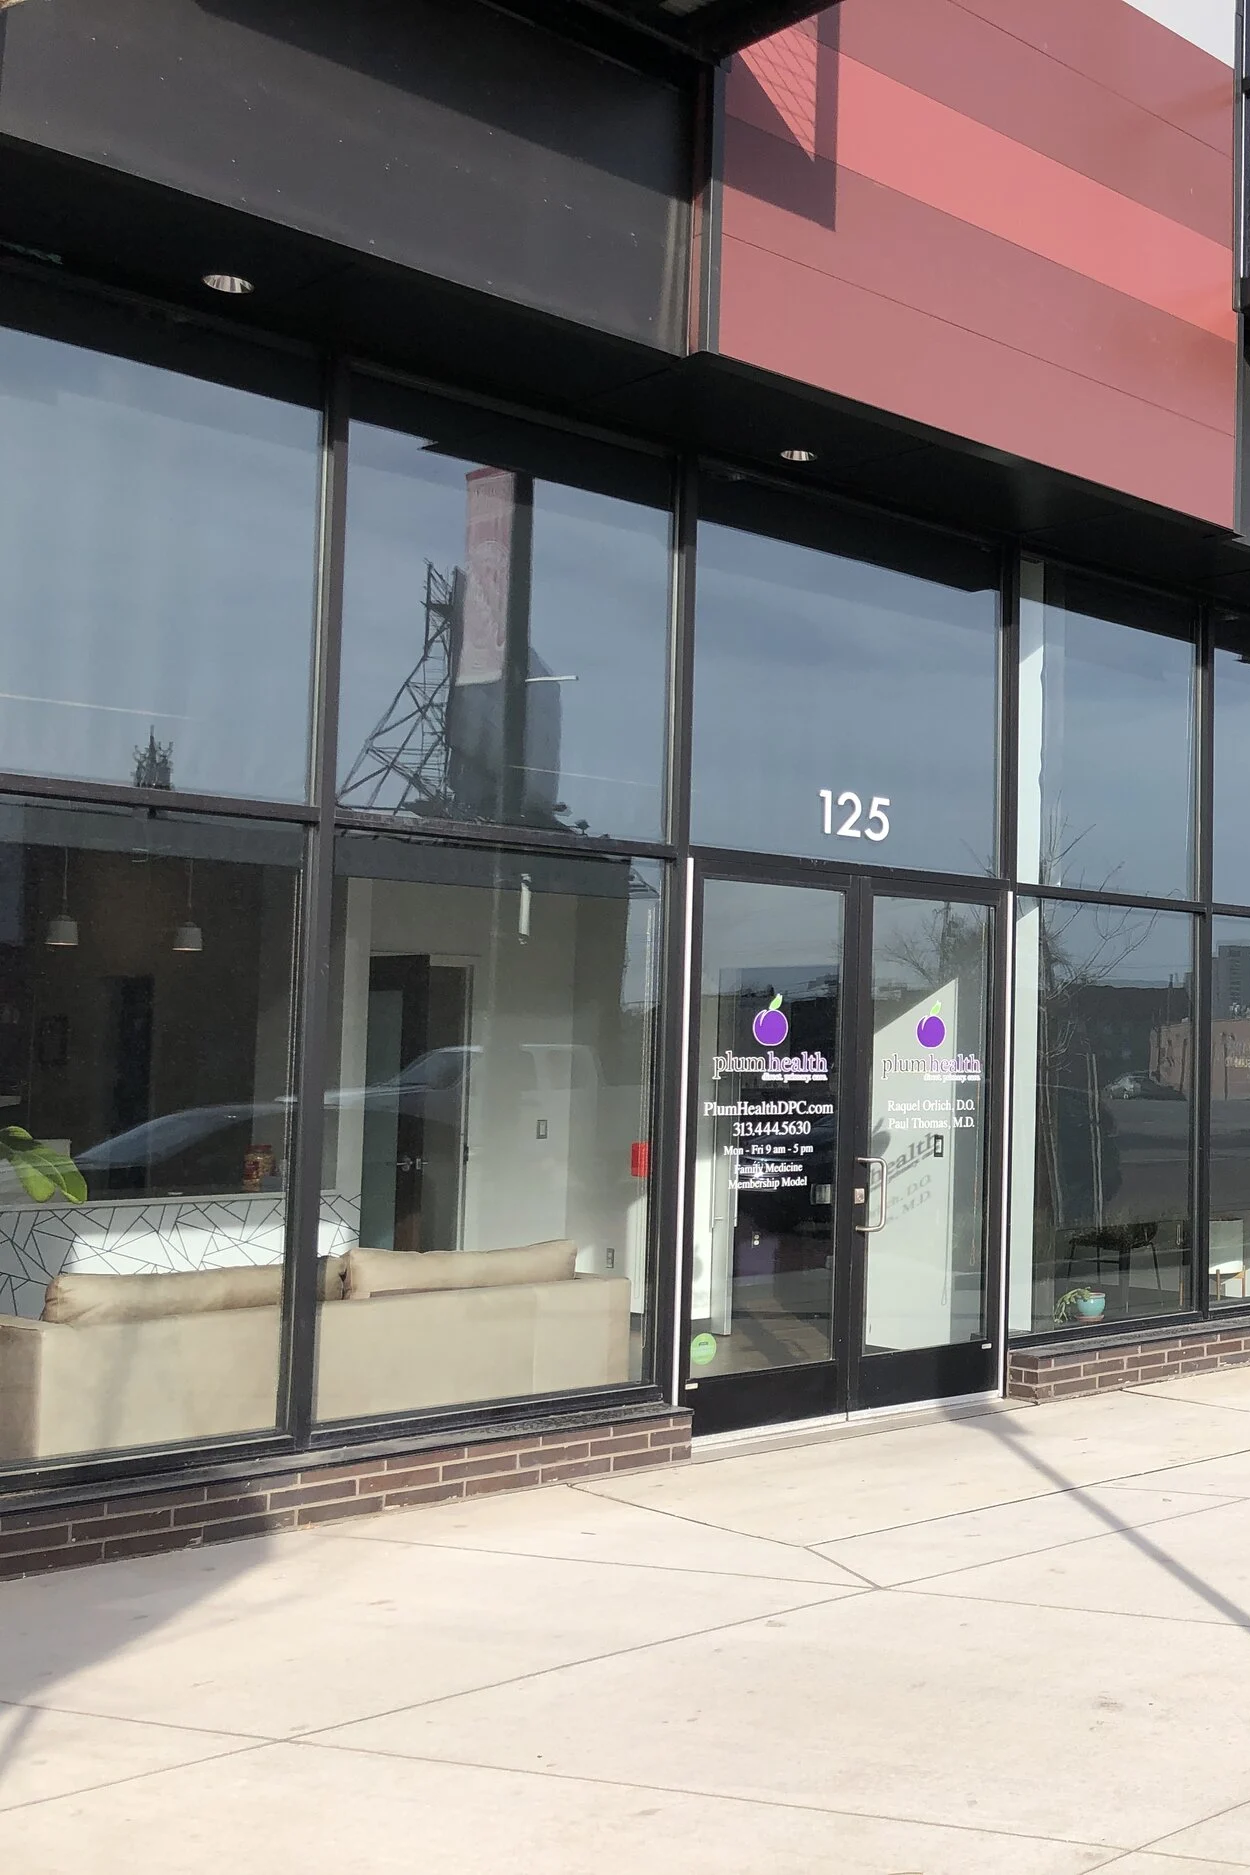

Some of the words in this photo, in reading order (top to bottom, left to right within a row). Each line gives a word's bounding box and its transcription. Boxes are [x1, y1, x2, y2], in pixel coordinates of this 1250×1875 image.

[819, 789, 890, 841] 125
[703, 1100, 834, 1117] PlumHealthDPC.com
[887, 1100, 920, 1114] Raquel
[922, 1099, 955, 1113] Orlich,
[957, 1099, 976, 1111] D.O.
[732, 1120, 812, 1137] 313.444.5630
[888, 1117, 909, 1129] Paul
[911, 1117, 951, 1130] Thomas,
[953, 1116, 975, 1128] M.D.
[723, 1145, 744, 1156] Mon
[751, 1144, 764, 1155] Fri
[765, 1144, 772, 1154] 9
[773, 1146, 786, 1154] am
[793, 1143, 799, 1153] 5
[800, 1144, 814, 1156] pm
[734, 1162, 763, 1176] Family
[765, 1162, 803, 1173] Medicine
[728, 1178, 780, 1190] Membership
[781, 1175, 808, 1187] Model
